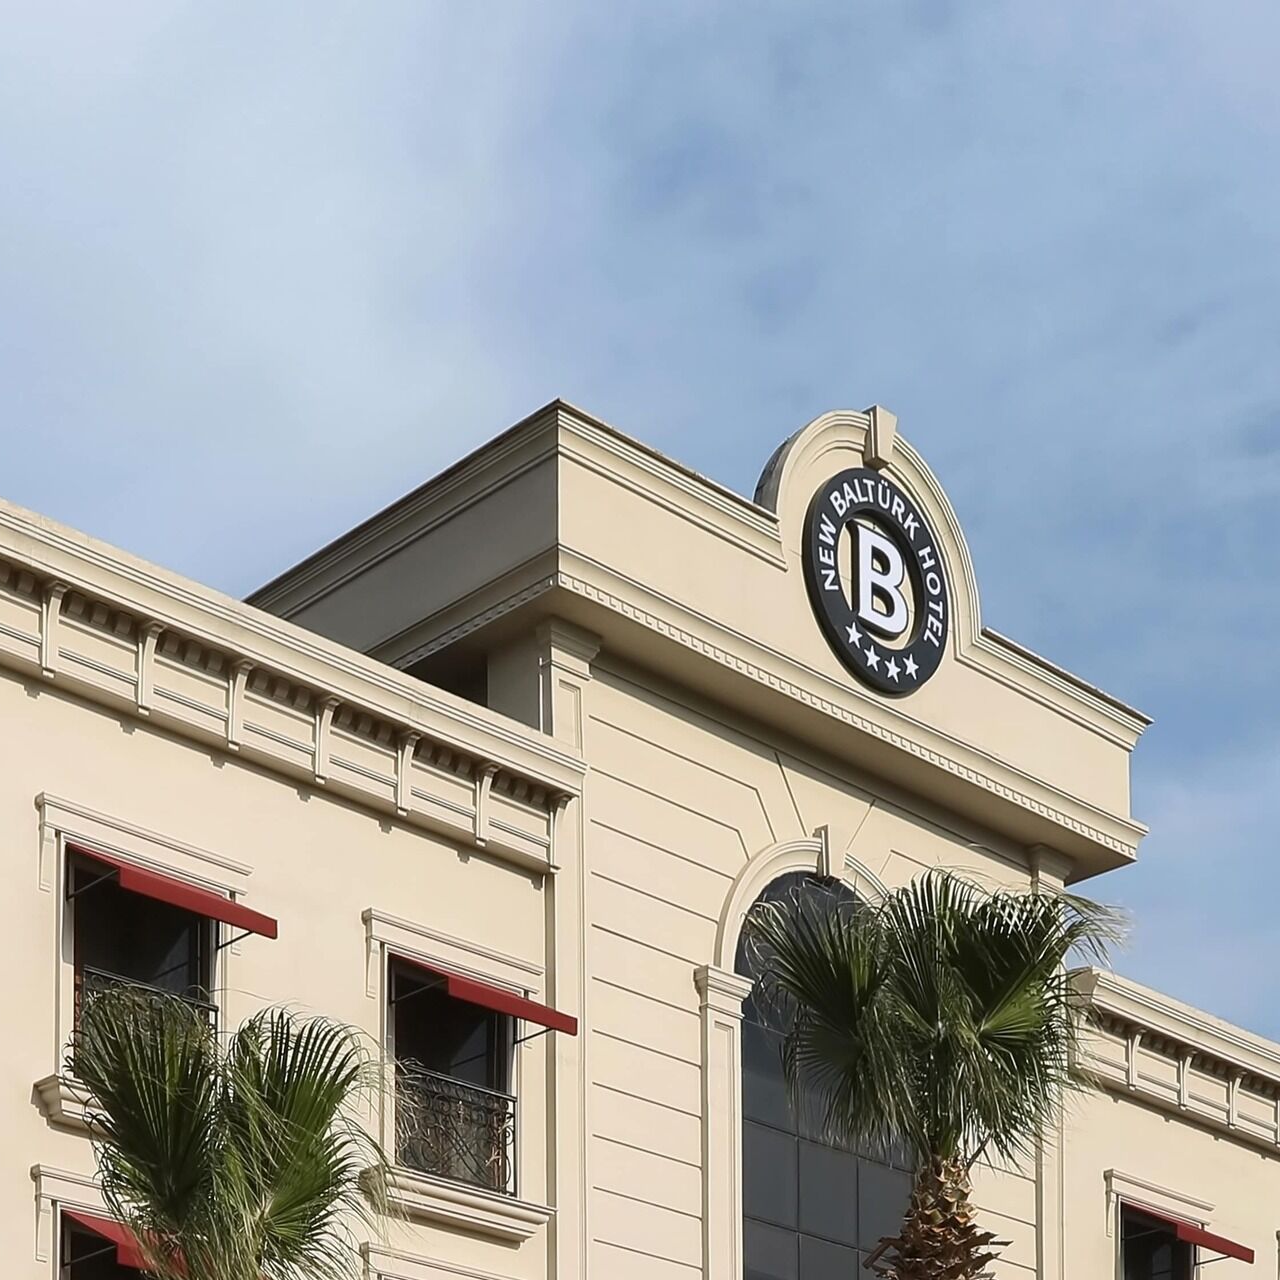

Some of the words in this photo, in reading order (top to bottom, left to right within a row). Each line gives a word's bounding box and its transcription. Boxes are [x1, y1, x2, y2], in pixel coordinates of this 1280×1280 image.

[819, 513, 839, 591] NEW
[830, 478, 920, 541] BALTÜRK
[919, 545, 943, 648] HOTEL
[857, 524, 909, 634] B
